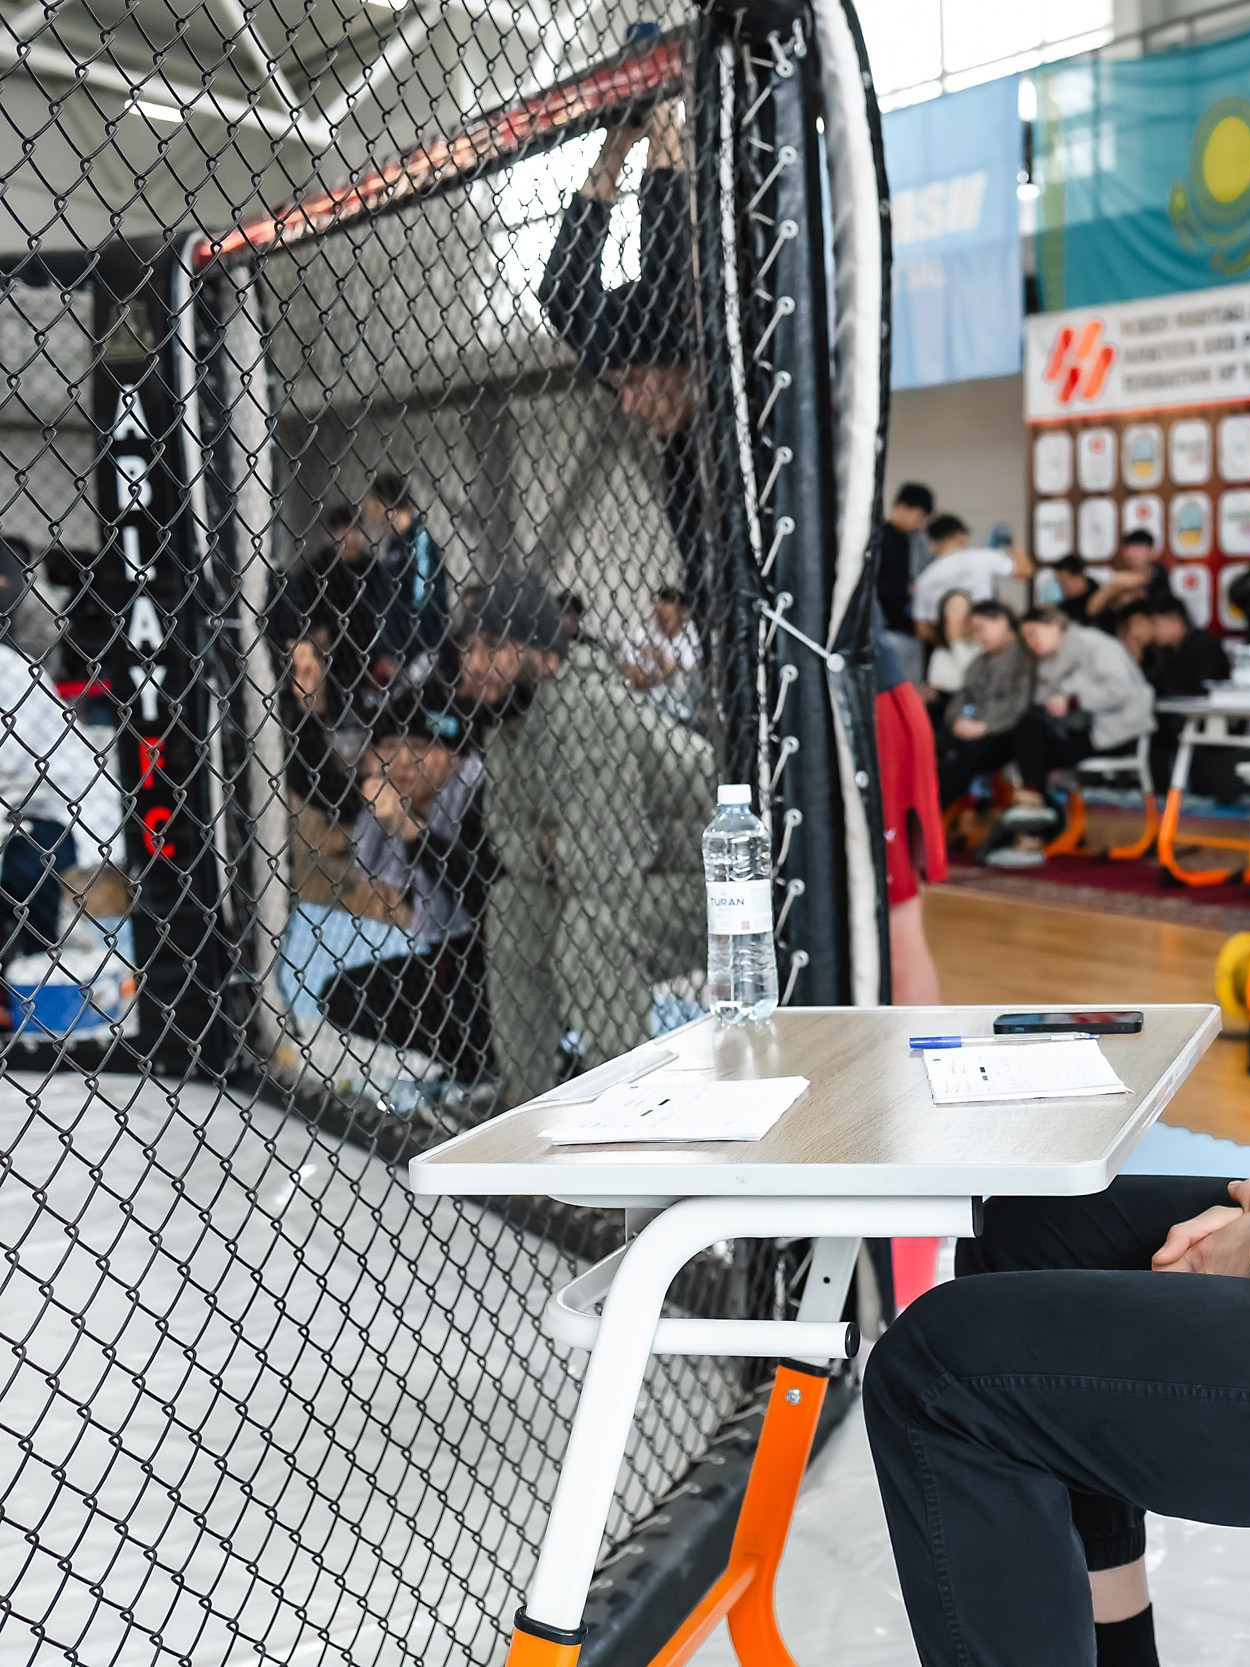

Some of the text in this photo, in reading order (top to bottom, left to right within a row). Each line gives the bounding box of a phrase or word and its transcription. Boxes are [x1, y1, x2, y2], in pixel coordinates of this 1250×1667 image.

[112, 382, 176, 860] ABLAY FC
[710, 897, 745, 907] TURAN
